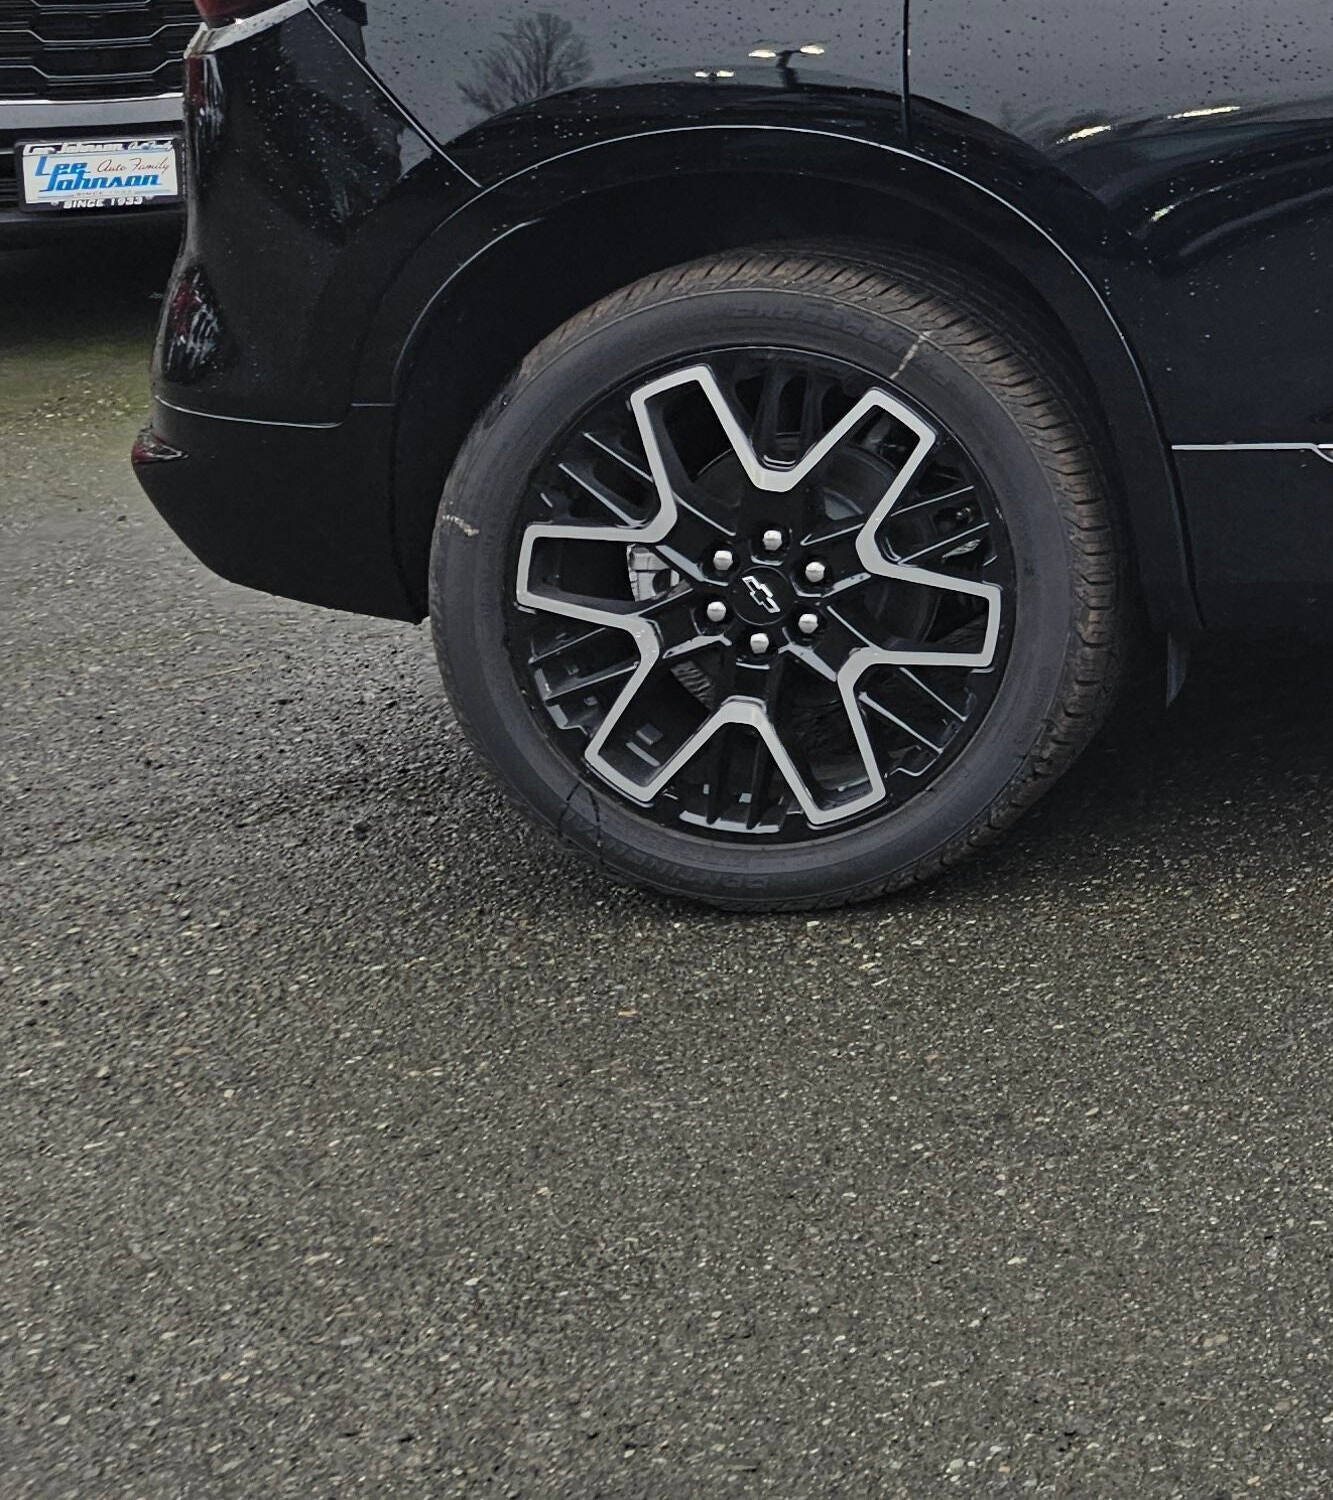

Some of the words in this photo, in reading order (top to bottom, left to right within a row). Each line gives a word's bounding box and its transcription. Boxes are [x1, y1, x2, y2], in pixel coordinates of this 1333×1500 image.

[35, 155, 92, 177] Lee
[96, 159, 128, 173] Auto
[130, 157, 170, 175] Family
[38, 170, 162, 193] Johnson
[63, 198, 105, 209] SINCE
[110, 195, 144, 206] 1933
